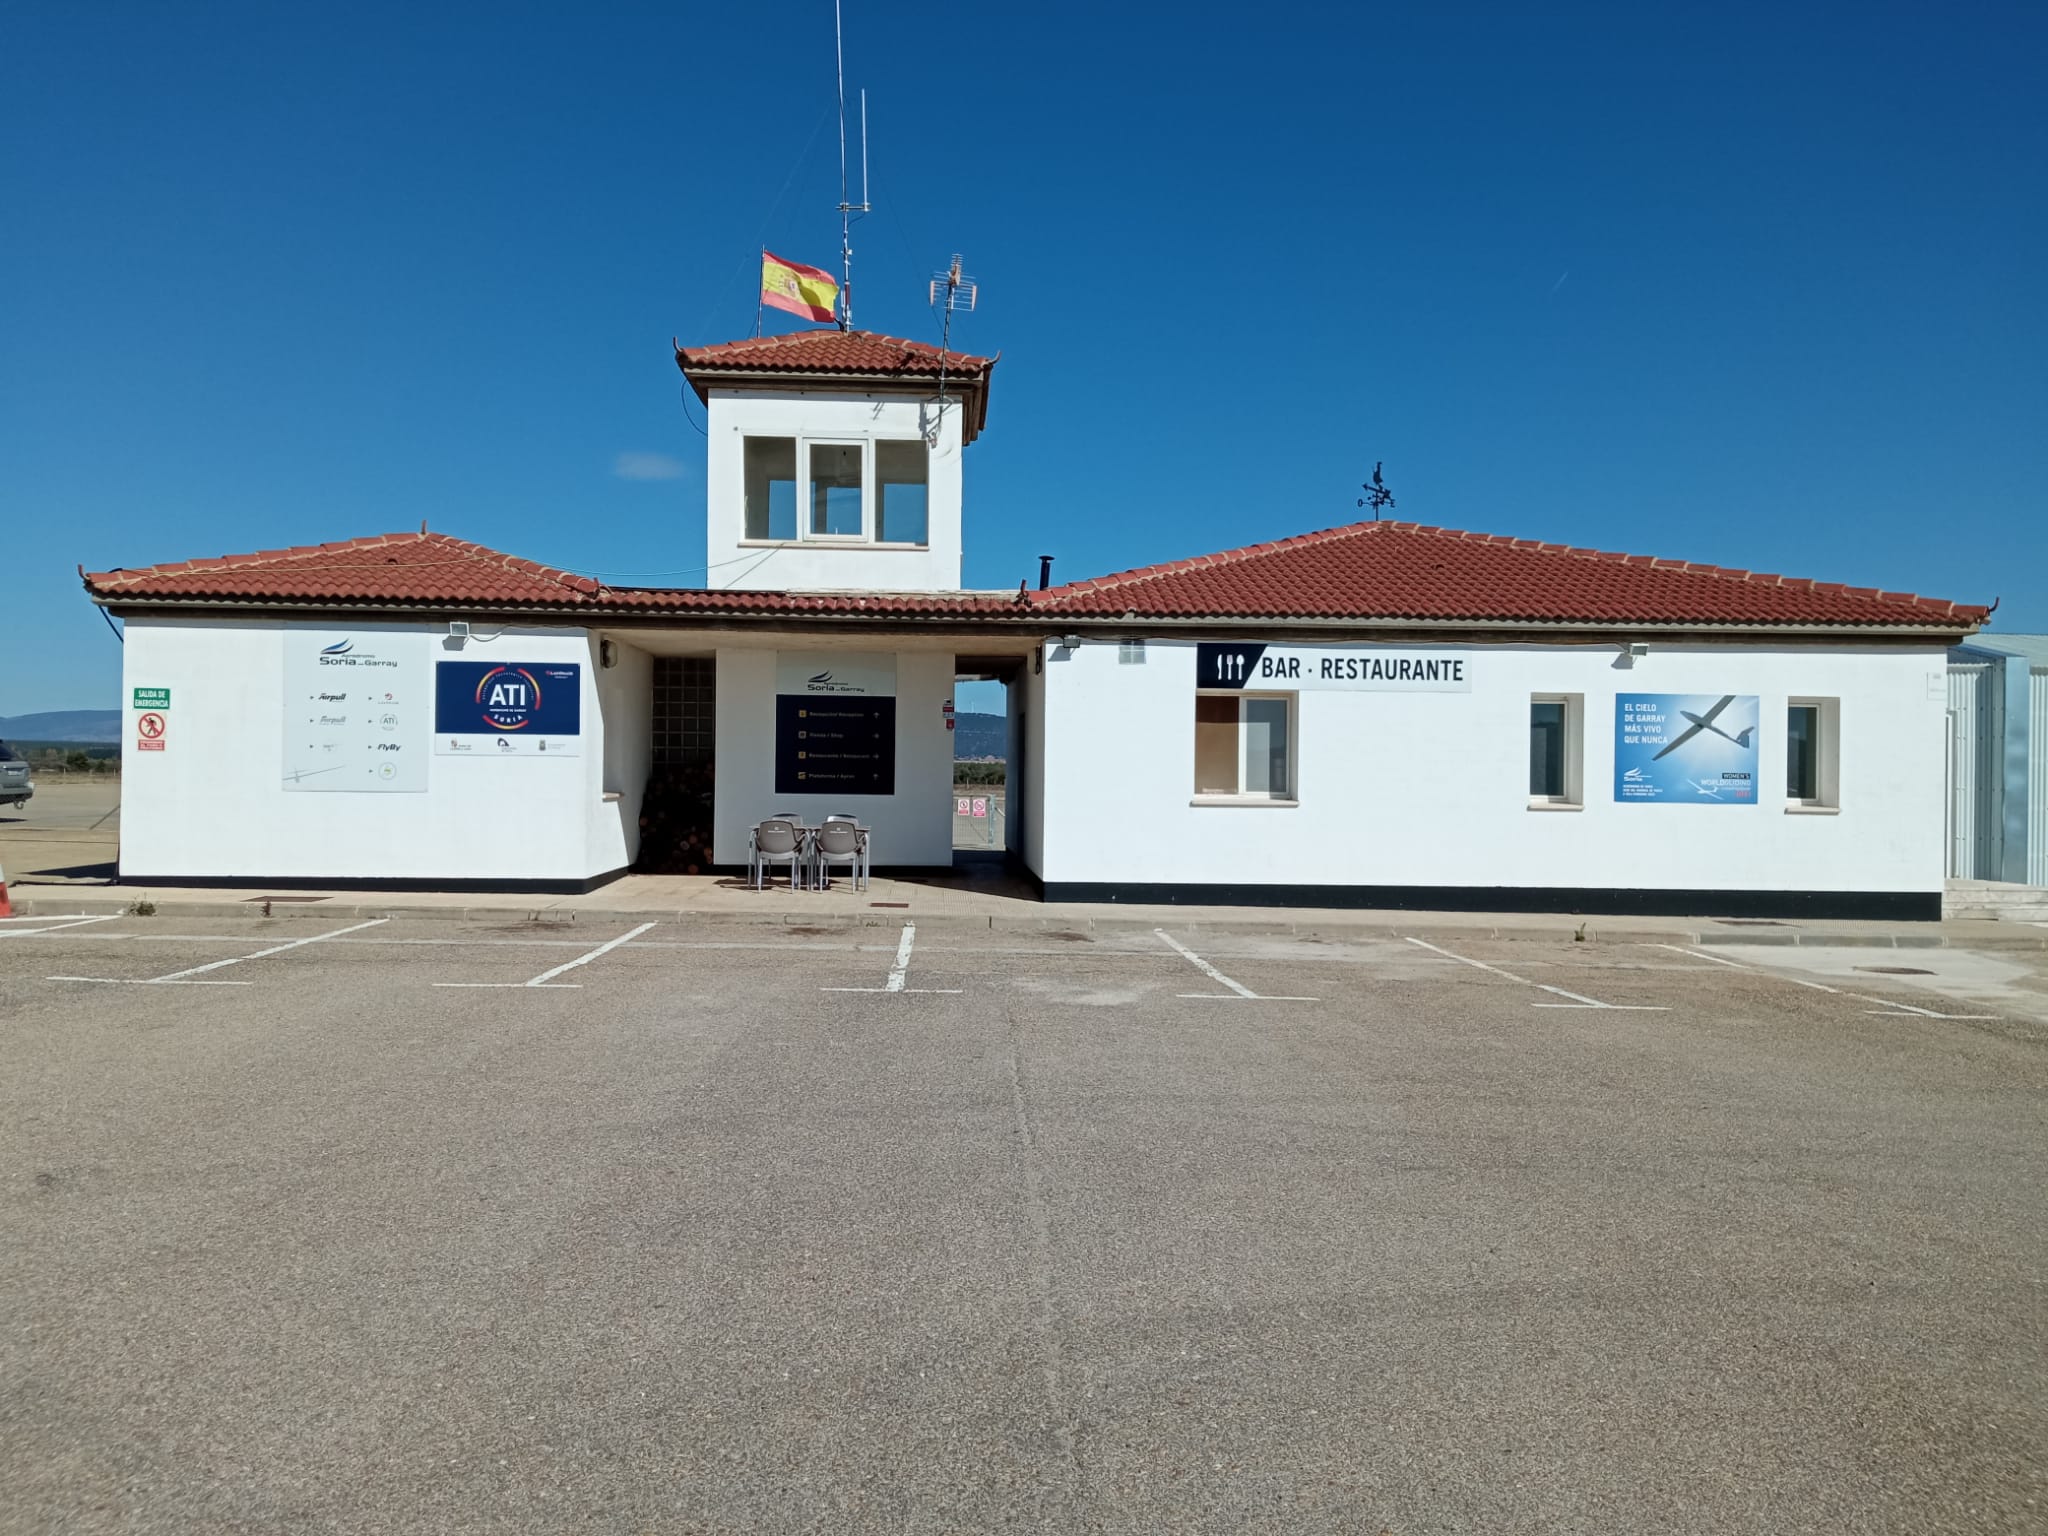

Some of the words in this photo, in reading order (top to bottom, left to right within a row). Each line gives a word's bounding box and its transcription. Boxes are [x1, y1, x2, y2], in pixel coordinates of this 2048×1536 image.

[319, 657, 356, 665] Soria
[1261, 657, 1300, 679] BAR
[1320, 658, 1464, 682] RESTAURANTE
[807, 683, 835, 692] Soria
[138, 690, 157, 698] SALIDA
[158, 690, 166, 698] DE
[489, 684, 525, 706] ATI
[1624, 703, 1634, 712] EL
[1635, 703, 1657, 712] CIELO
[1624, 714, 1635, 722] DE
[1636, 714, 1666, 722] GARRAY
[1624, 723, 1642, 733] MÁS
[1643, 725, 1661, 733] VIVO
[1624, 735, 1640, 744] QUE
[1641, 735, 1668, 744] NUNCA
